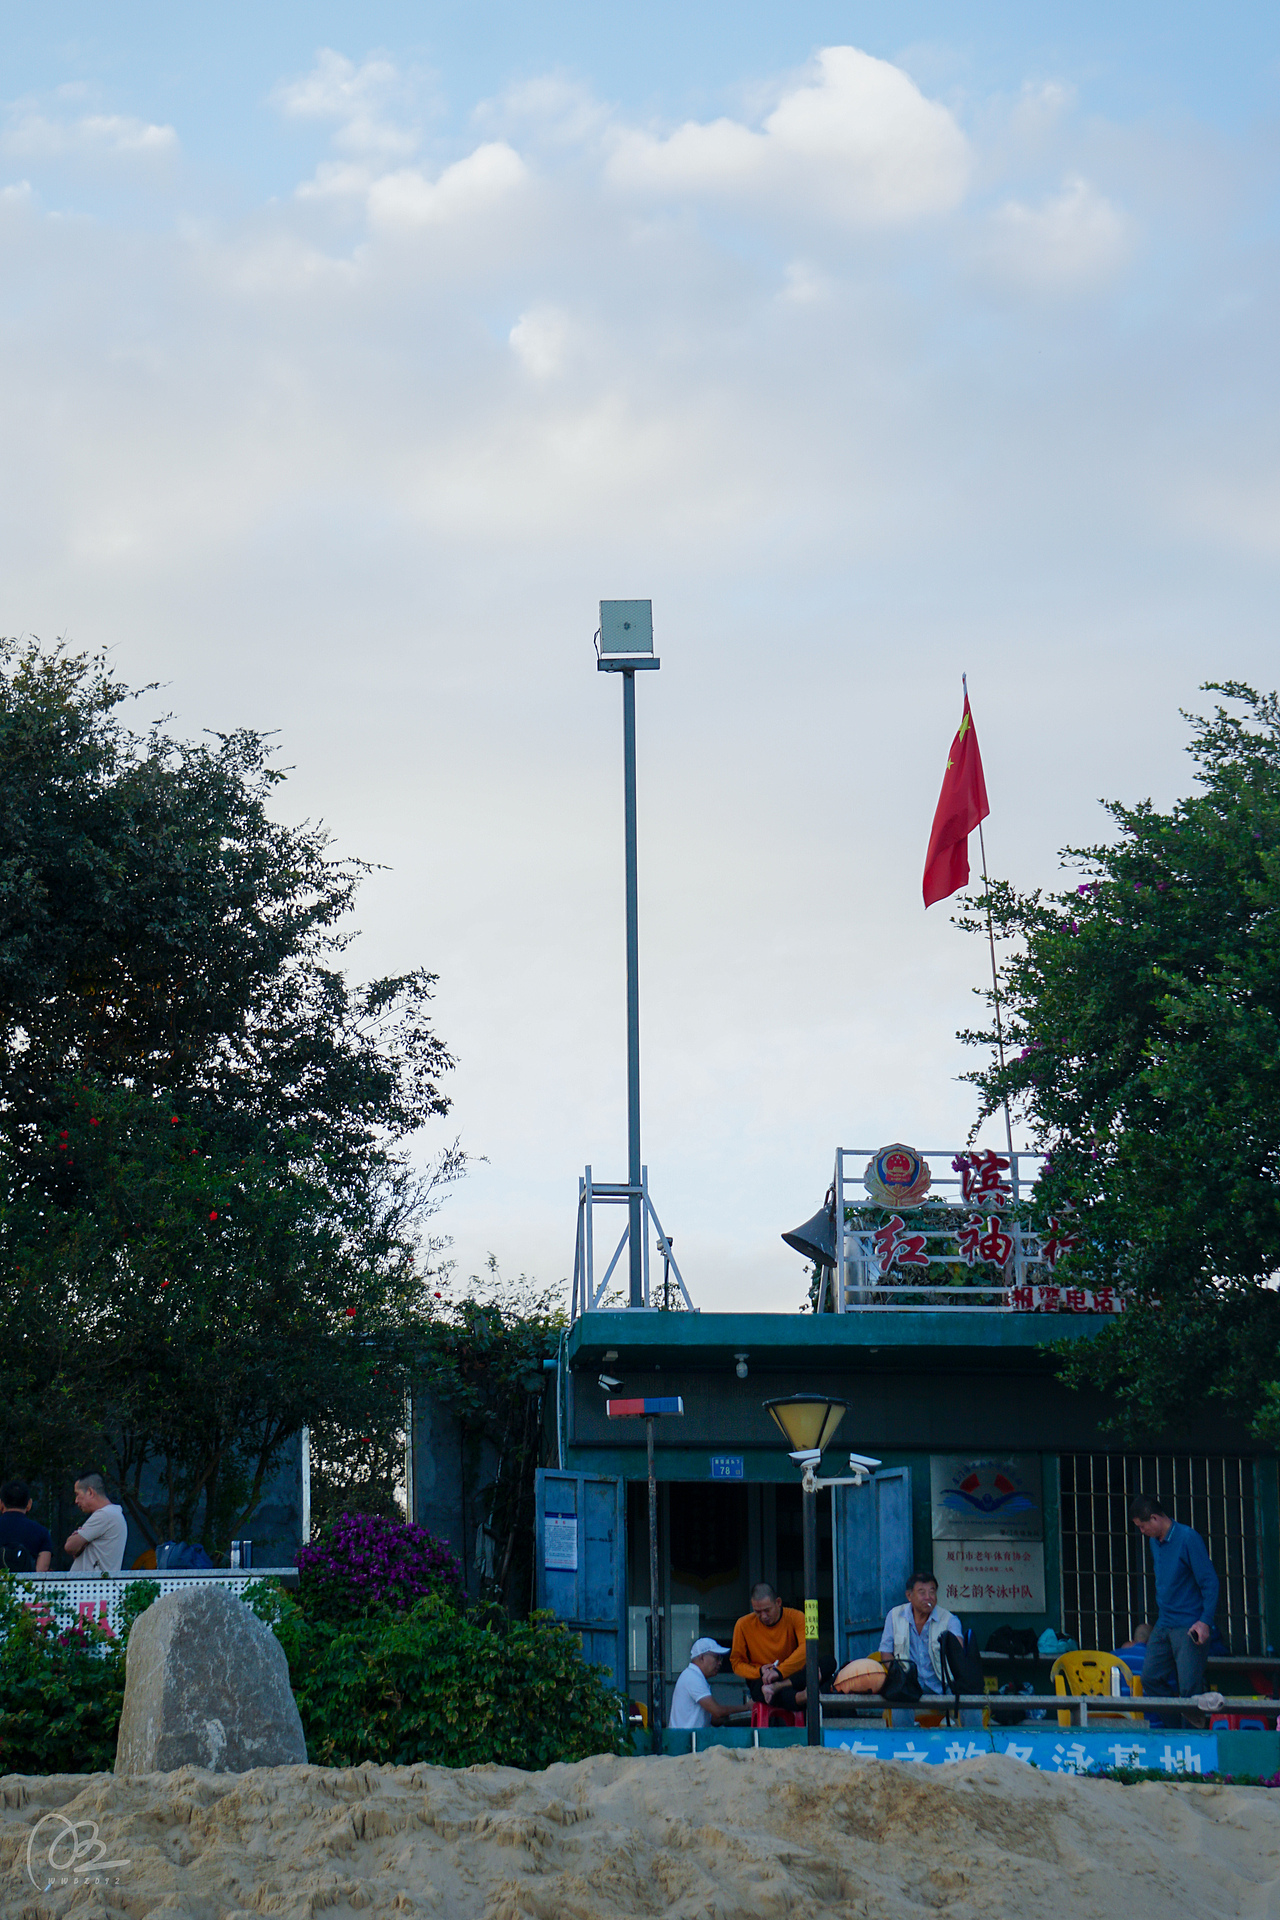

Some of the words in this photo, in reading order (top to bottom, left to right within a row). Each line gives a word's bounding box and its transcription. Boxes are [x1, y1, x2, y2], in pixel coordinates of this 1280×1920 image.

[720, 1466, 730, 1475] 78
[946, 1550, 1031, 1561] 厦门市老年体育协会
[946, 1583, 1033, 1599] 海之韵冬泳中队
